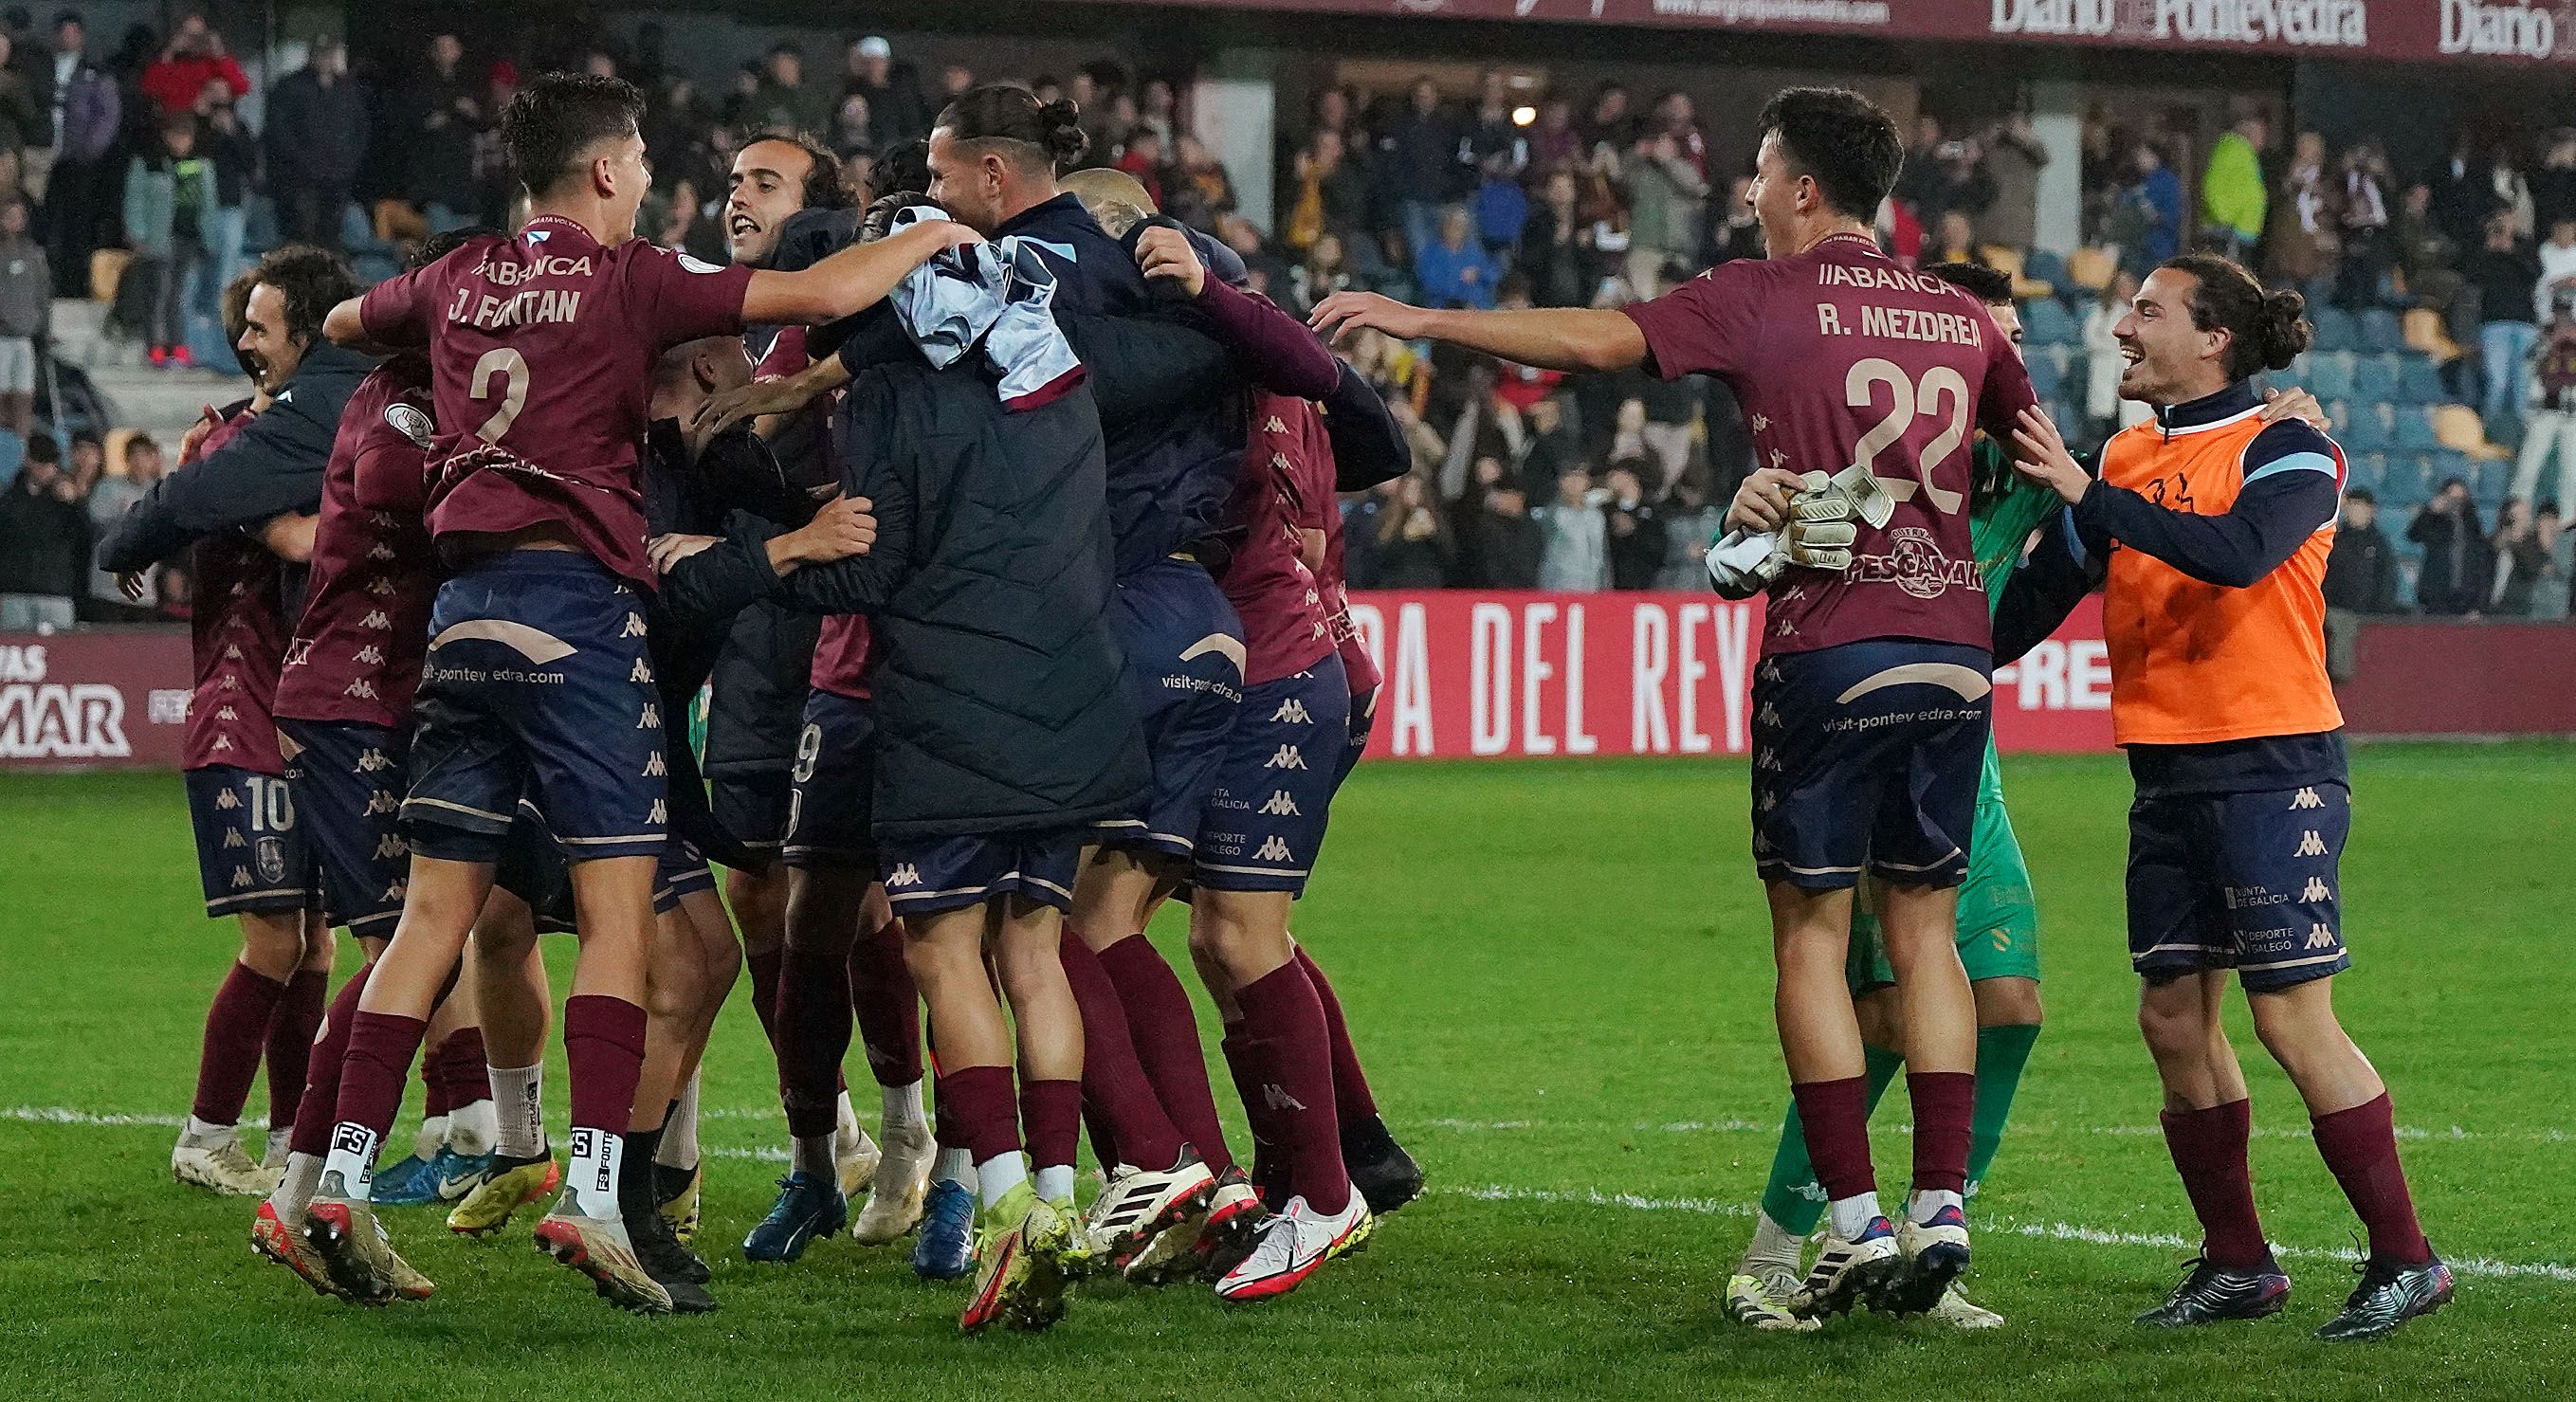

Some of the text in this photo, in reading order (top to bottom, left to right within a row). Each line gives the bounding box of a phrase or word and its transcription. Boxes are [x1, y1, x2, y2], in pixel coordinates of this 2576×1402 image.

[474, 290, 581, 331] FONTAN
[1818, 303, 1982, 352] R. MEZDREA
[470, 347, 530, 444] 2
[1845, 357, 1969, 516] 22
[1471, 602, 1599, 756] DEL
[1631, 602, 1751, 755] REY
[1991, 639, 2111, 710] RE
[795, 722, 822, 783] 9
[245, 775, 295, 832] 10
[2249, 893, 2290, 906] GALICIA
[2248, 927, 2294, 941] DEPORTE
[336, 1126, 367, 1154] FS
